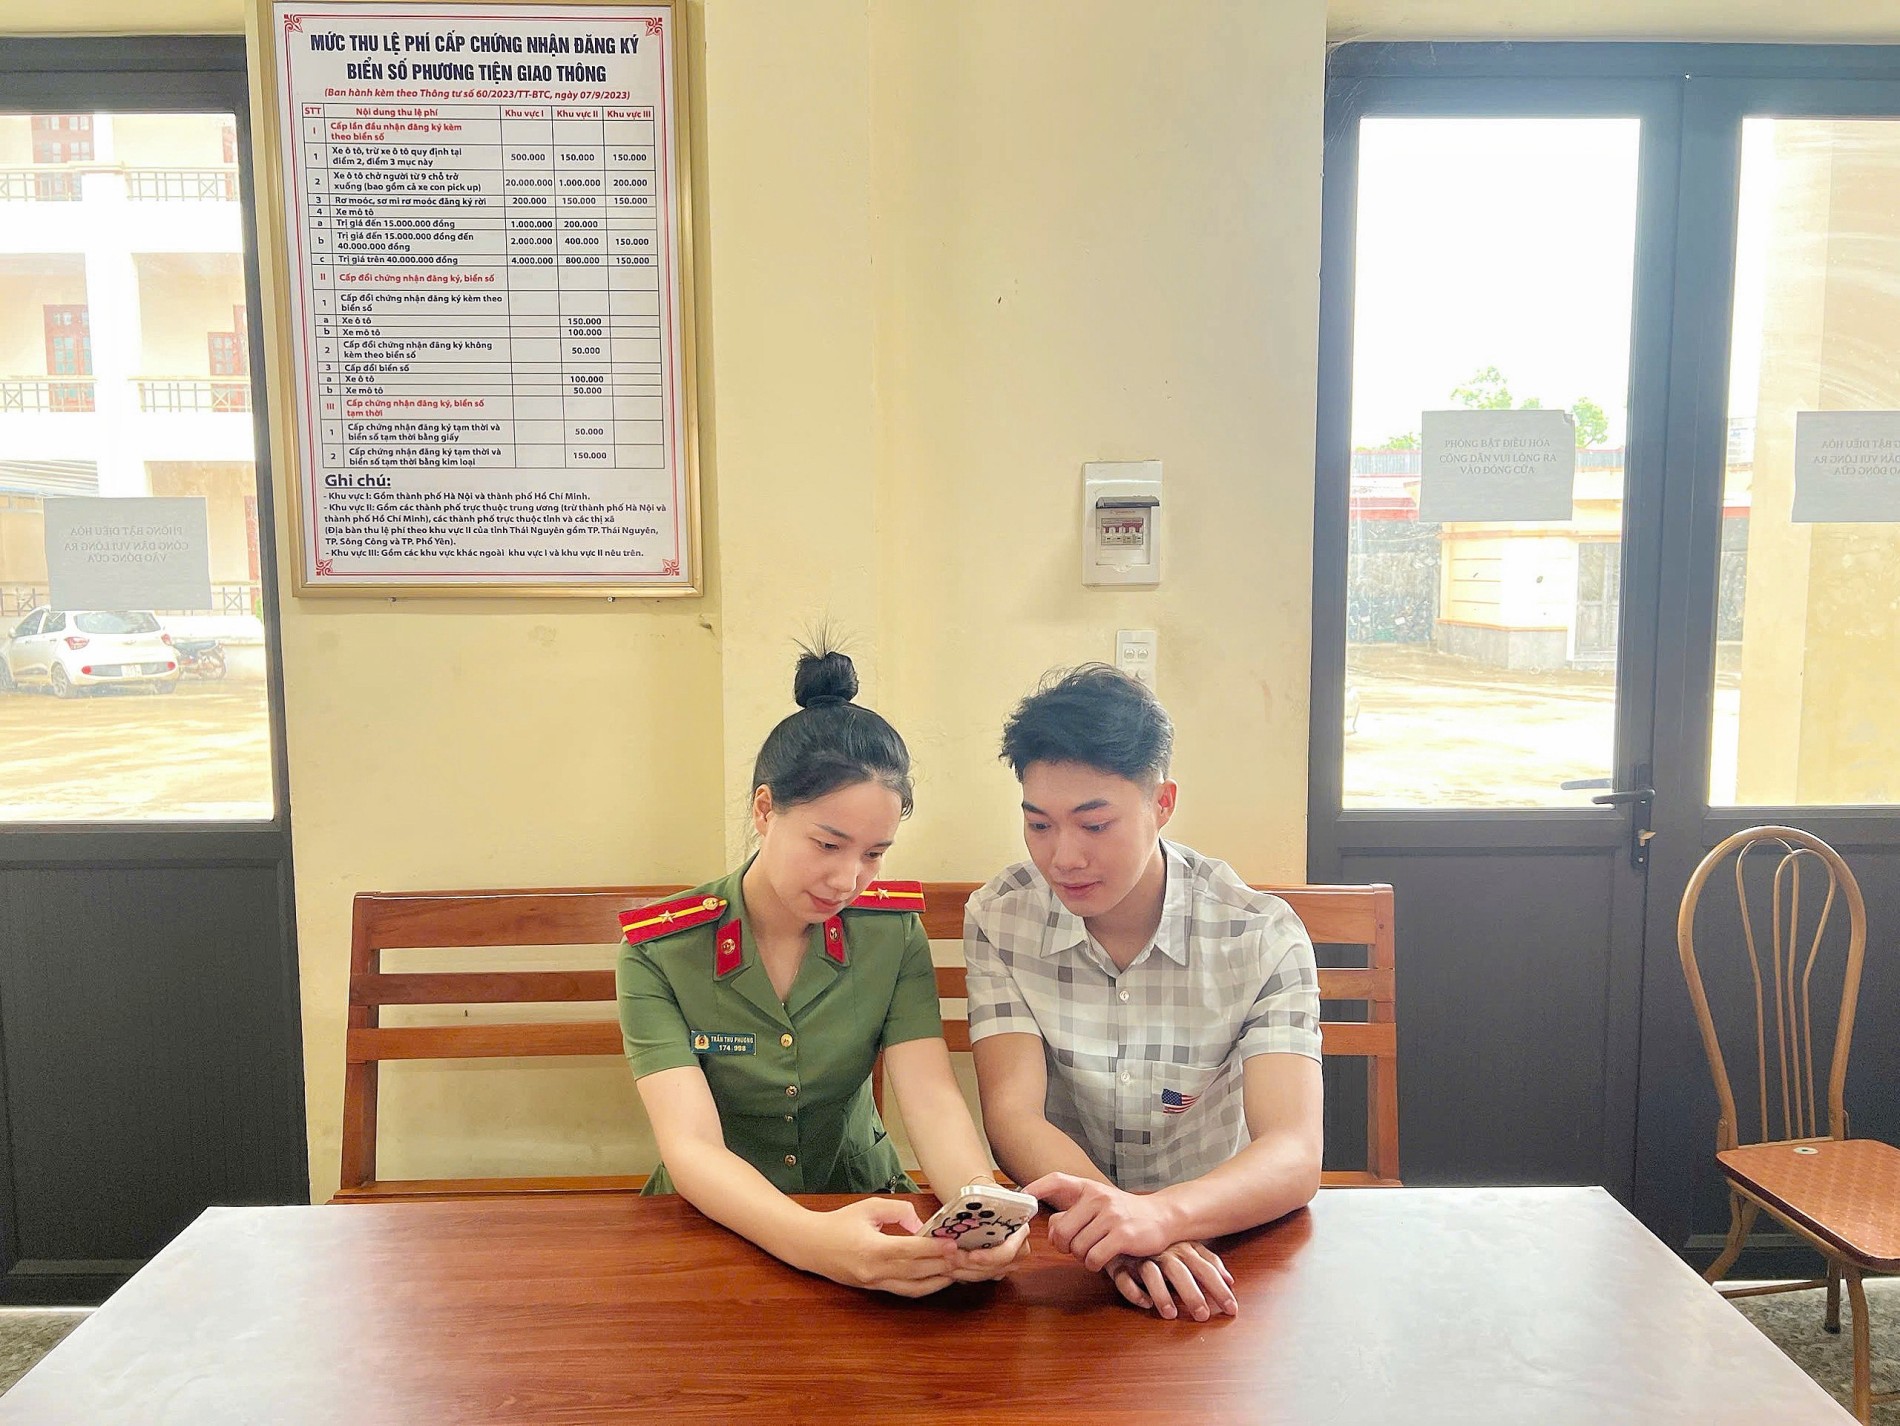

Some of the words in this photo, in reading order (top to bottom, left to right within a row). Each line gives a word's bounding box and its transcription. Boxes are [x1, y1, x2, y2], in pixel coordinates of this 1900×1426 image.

[310, 29, 345, 51] MỨC
[348, 34, 378, 52] THU
[382, 30, 400, 55] LỆ
[404, 29, 430, 52] PHÍ
[434, 30, 465, 52] CẤP
[470, 30, 522, 53] CHỨNG
[526, 32, 569, 57] NHẬN
[573, 33, 615, 54] ĐĂNG
[619, 31, 639, 54] KÝ
[347, 56, 382, 80] BIỂN
[387, 56, 407, 80] SỐ
[412, 60, 474, 81] PHƯƠNG
[478, 60, 512, 85] TIỆN
[517, 64, 551, 82] GIAO
[556, 61, 606, 82] THÔNG
[324, 87, 346, 97] (Ban
[348, 88, 373, 96] hành
[374, 88, 394, 97] kèm
[396, 88, 418, 97] theo
[418, 88, 450, 99] Thông
[463, 88, 474, 98] số
[554, 90, 578, 101] ngày
[579, 90, 630, 100] 07/9/2023)
[304, 106, 324, 114] STT
[372, 107, 396, 118] dung
[396, 107, 412, 118] thu
[504, 109, 522, 119] Khu
[556, 110, 574, 120] Khu
[606, 110, 624, 120] Khu
[330, 132, 352, 140] theo
[560, 153, 595, 161] 150.000
[612, 153, 647, 161] 150.000
[503, 178, 555, 187] 20.000.000
[558, 178, 601, 186] 1.000.000
[612, 178, 648, 186] 200.000
[335, 208, 347, 217] Xe
[383, 219, 430, 229] 15.000.000
[510, 220, 553, 228] 1.000.000
[563, 220, 598, 228] 200.000
[510, 237, 553, 245] 2.000.000
[386, 255, 434, 265] 40.000.000
[510, 256, 553, 264] 4.000.000
[565, 256, 600, 264] 800.000
[615, 256, 650, 264] 150.000
[567, 317, 602, 325] 150.000
[568, 328, 602, 336] 100.000
[571, 346, 600, 354] 50.000
[573, 451, 607, 459] 150.000
[1439, 453, 1468, 463] CÔNG
[1493, 454, 1511, 463] VUI
[1543, 454, 1557, 462] RA
[324, 473, 352, 486] Ghi
[356, 473, 391, 486] chú:
[328, 491, 346, 499] Khu
[564, 492, 590, 500] Minh.
